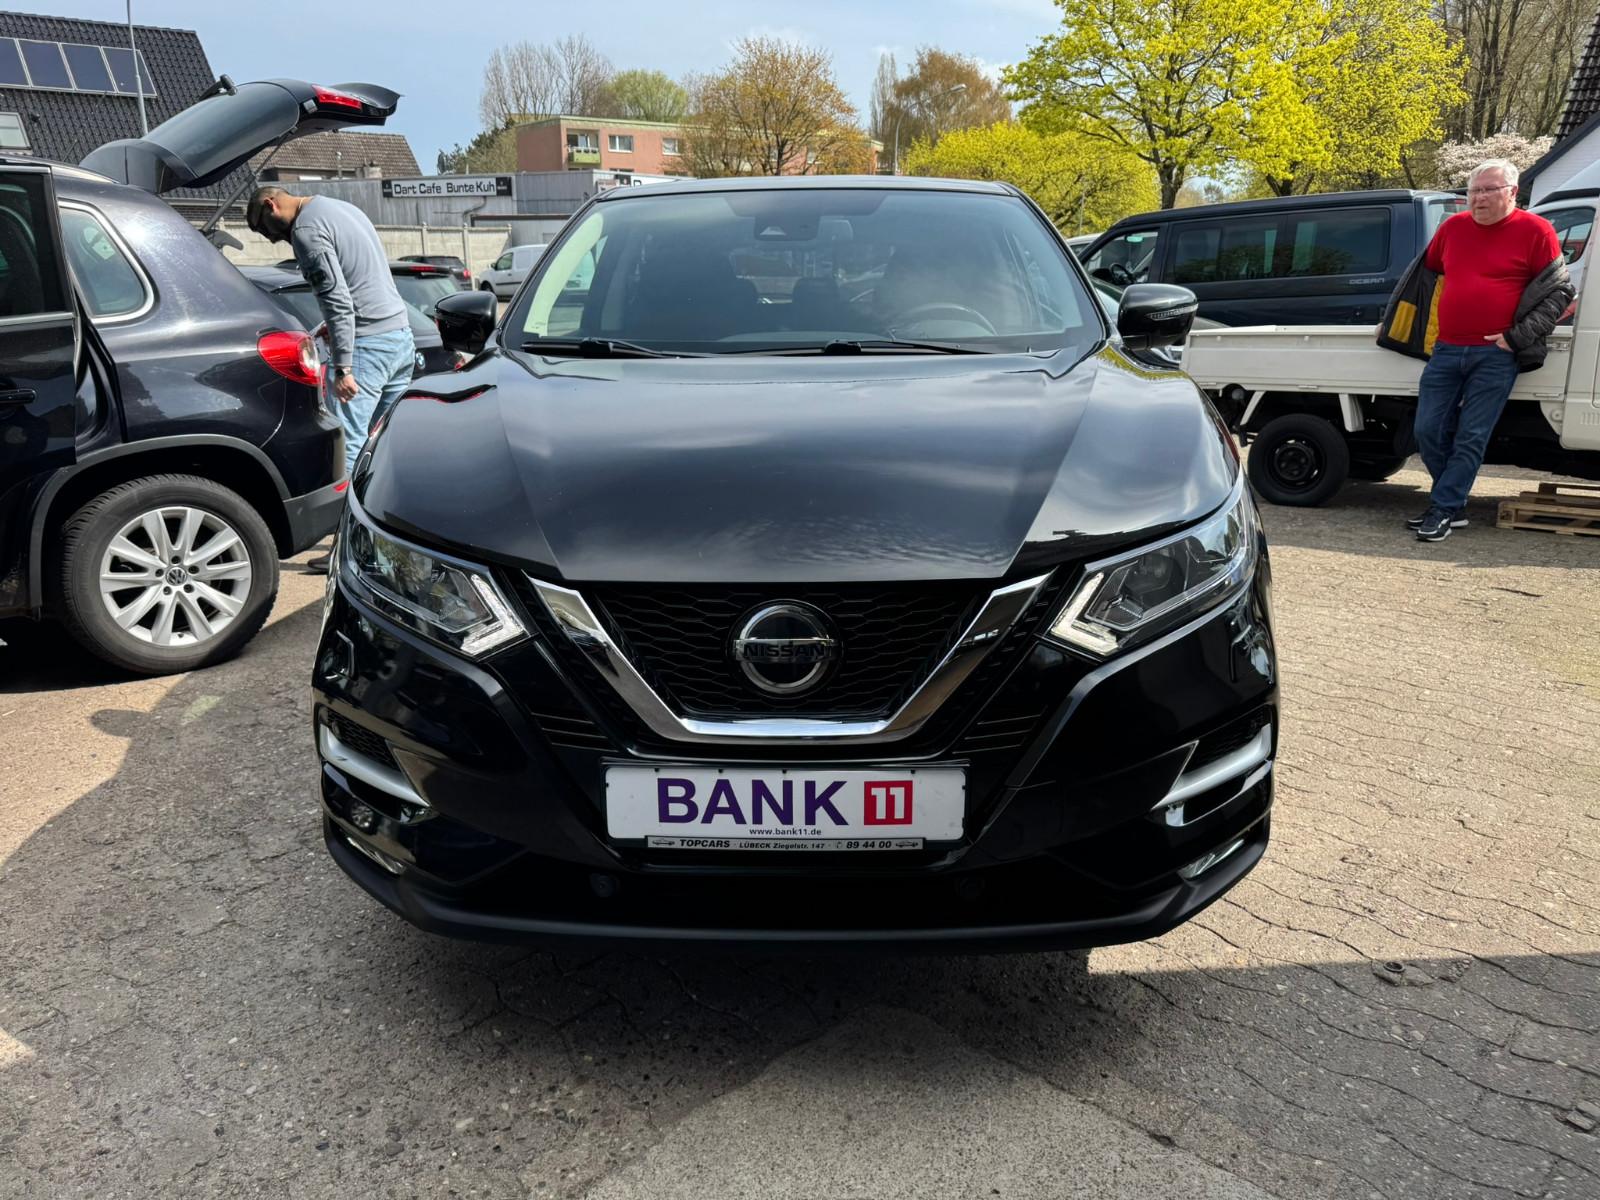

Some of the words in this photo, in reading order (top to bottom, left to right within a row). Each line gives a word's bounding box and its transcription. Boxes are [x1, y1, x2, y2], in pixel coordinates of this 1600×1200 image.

[394, 184, 417, 194] Dart
[419, 183, 442, 194] Cafe
[446, 182, 474, 193] Bunte
[475, 181, 496, 192] Kuh
[743, 642, 825, 657] NISSAN
[657, 778, 849, 825] BANK
[870, 786, 906, 820] 11
[749, 827, 822, 836] www.bank11.de
[679, 839, 731, 848] TOPCARS
[739, 840, 771, 849] LÜBECK
[846, 840, 860, 849] 89
[862, 840, 875, 848] 44
[878, 840, 892, 848] 00
